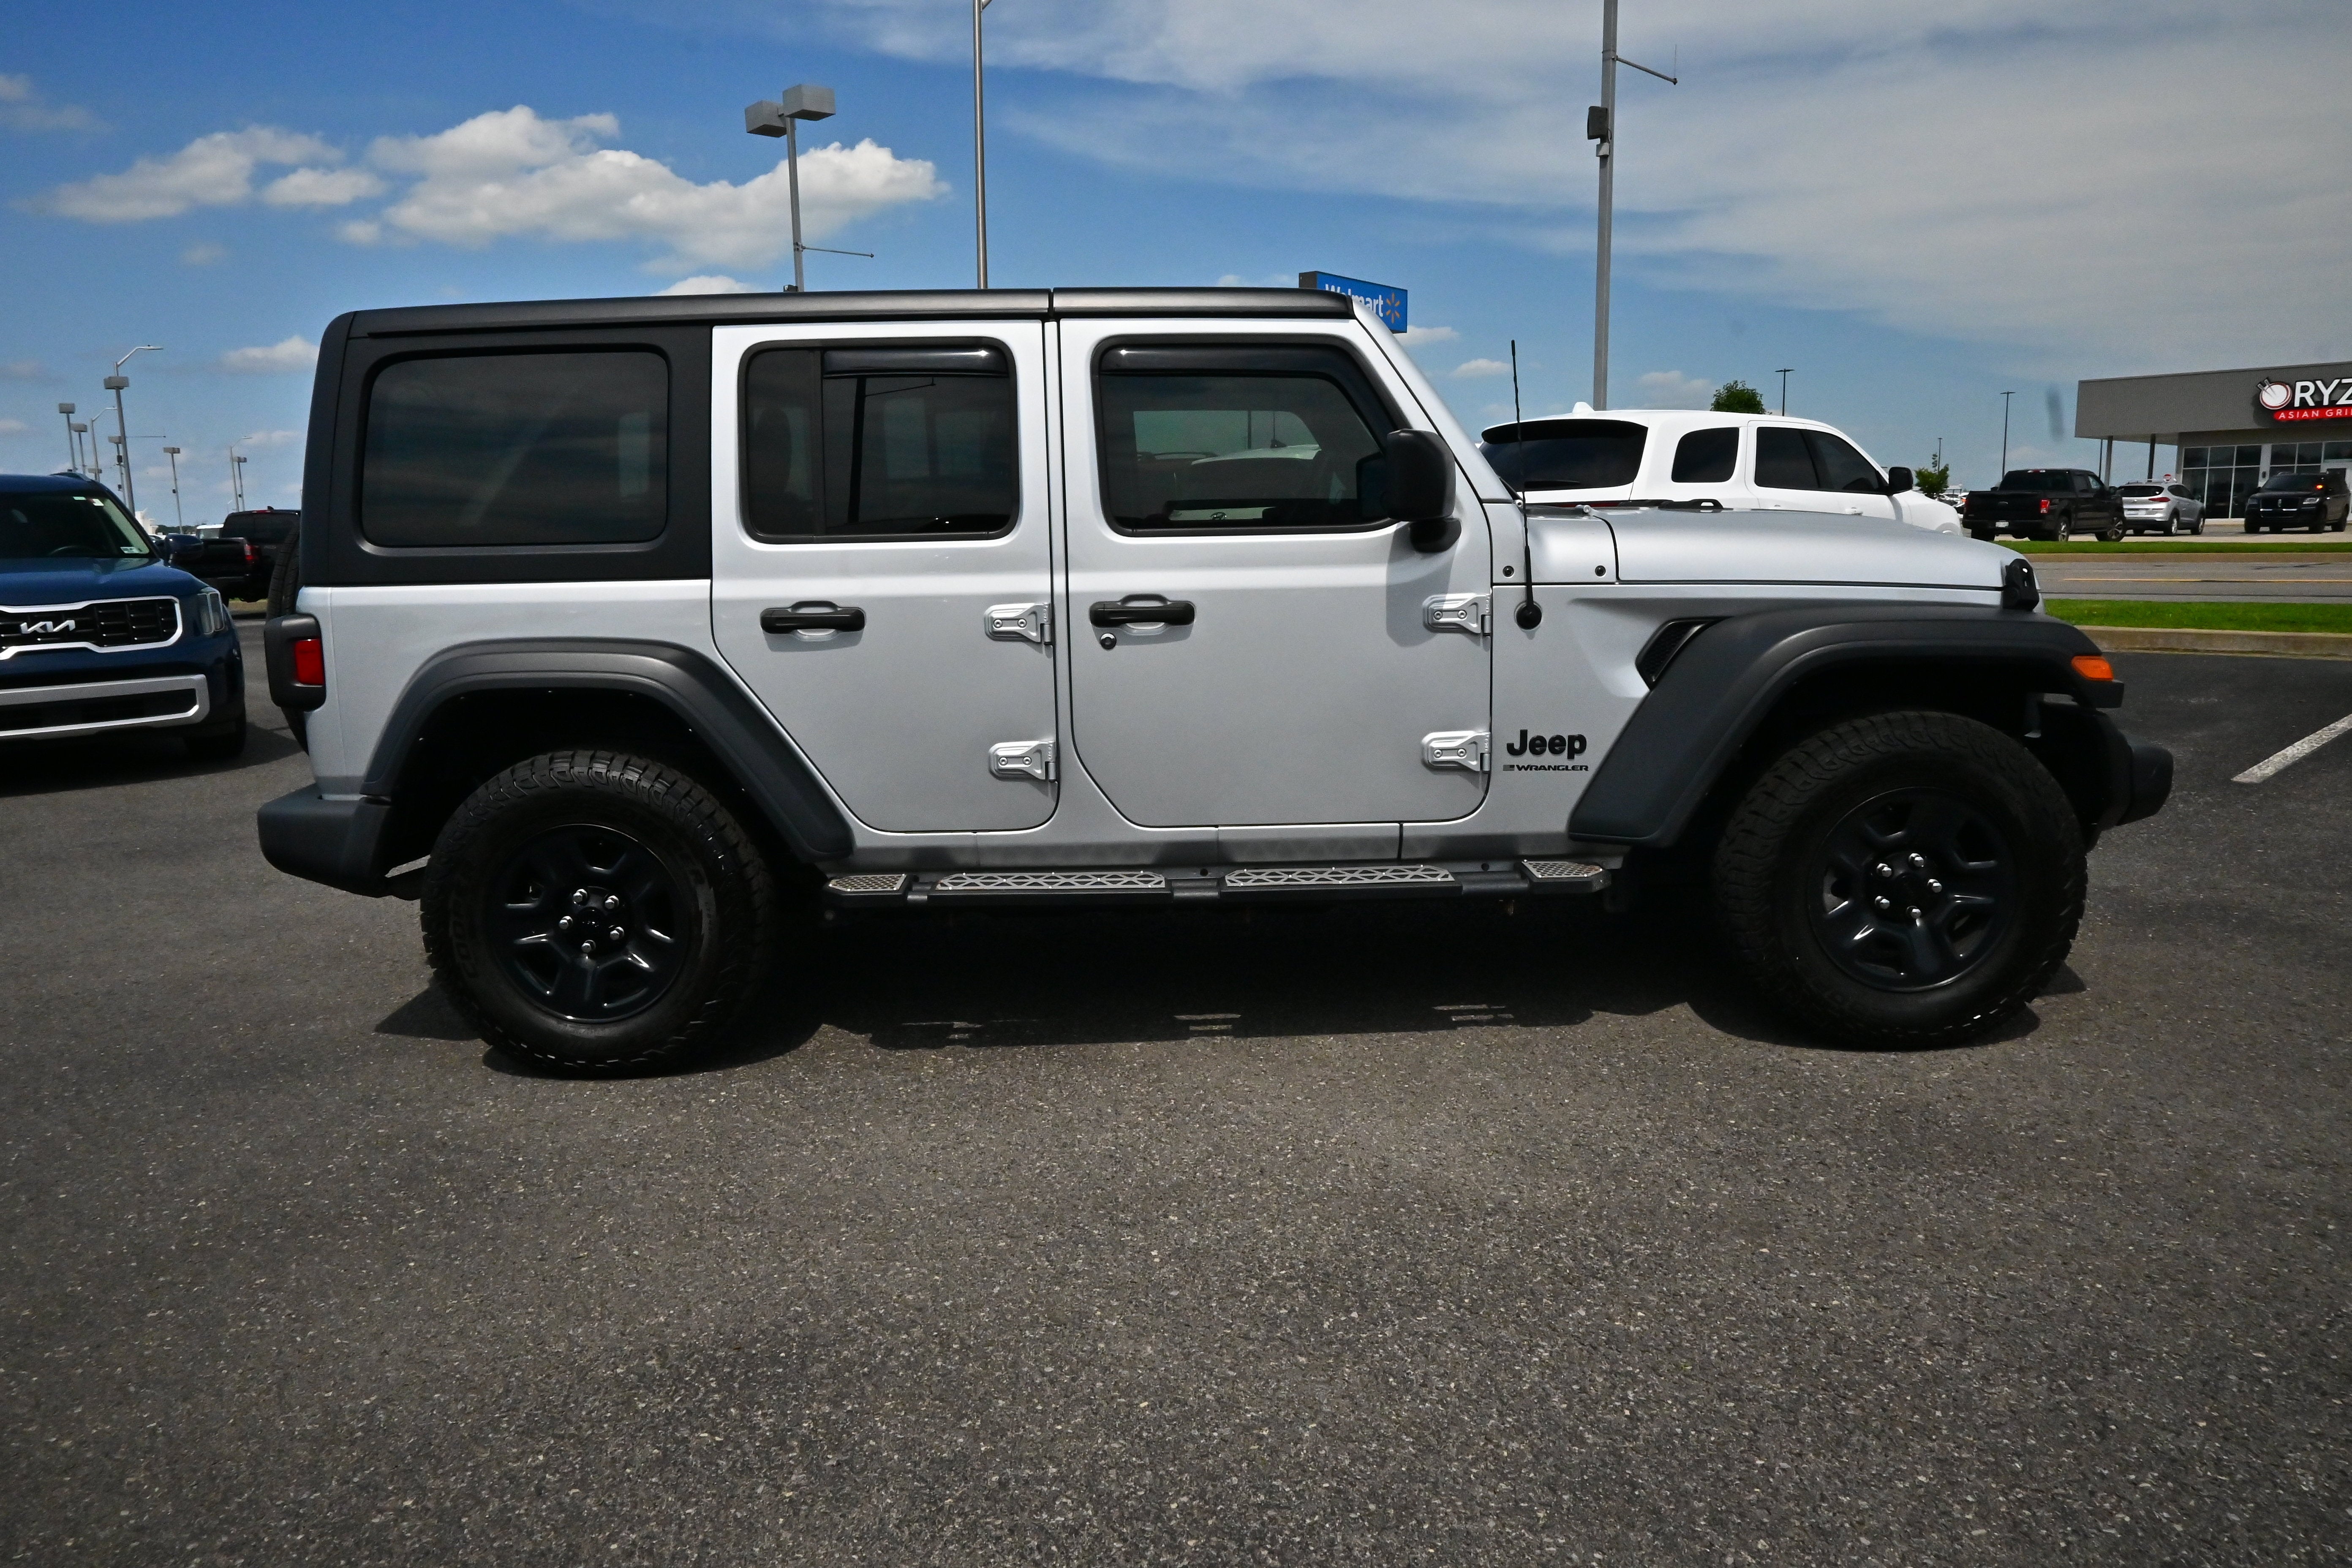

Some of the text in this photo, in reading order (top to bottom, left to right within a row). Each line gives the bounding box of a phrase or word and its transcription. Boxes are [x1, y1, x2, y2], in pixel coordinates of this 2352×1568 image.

[1325, 283, 1383, 317] mart
[2278, 408, 2352, 419] ASIAN GRI
[1506, 729, 1587, 760] Jeep
